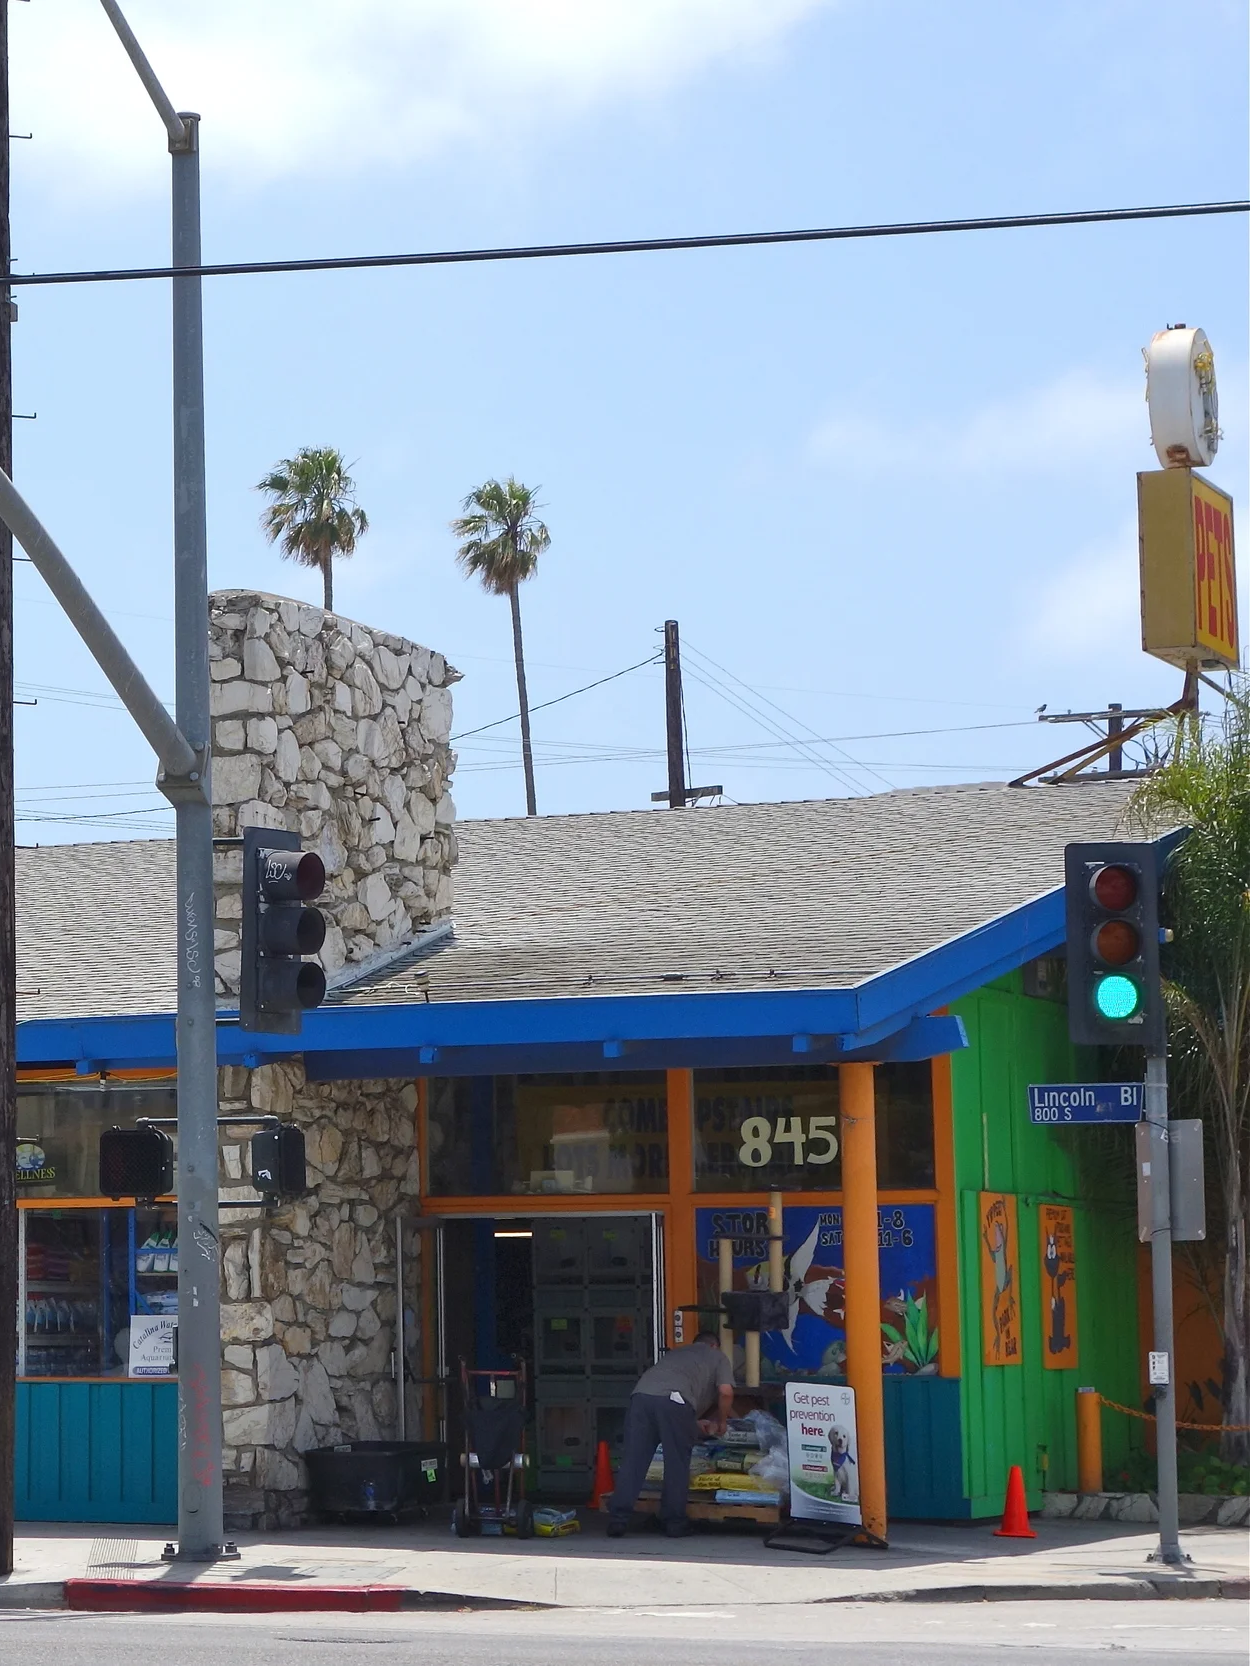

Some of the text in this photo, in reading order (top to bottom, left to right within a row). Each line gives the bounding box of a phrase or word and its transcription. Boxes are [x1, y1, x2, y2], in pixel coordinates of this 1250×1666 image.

[1194, 495, 1235, 648] PETS
[1034, 1088, 1095, 1107] Lincoln
[1034, 1108, 1072, 1121] 800 S
[738, 1116, 838, 1167] 845
[16, 1167, 56, 1180] ELLNESS
[712, 1211, 770, 1235] STOR
[819, 1213, 842, 1226] MON
[820, 1231, 843, 1247] SAT
[708, 1238, 767, 1259] HURS
[132, 1324, 160, 1349] Catalina
[793, 1391, 830, 1407] Get pest
[790, 1409, 836, 1422] prevention
